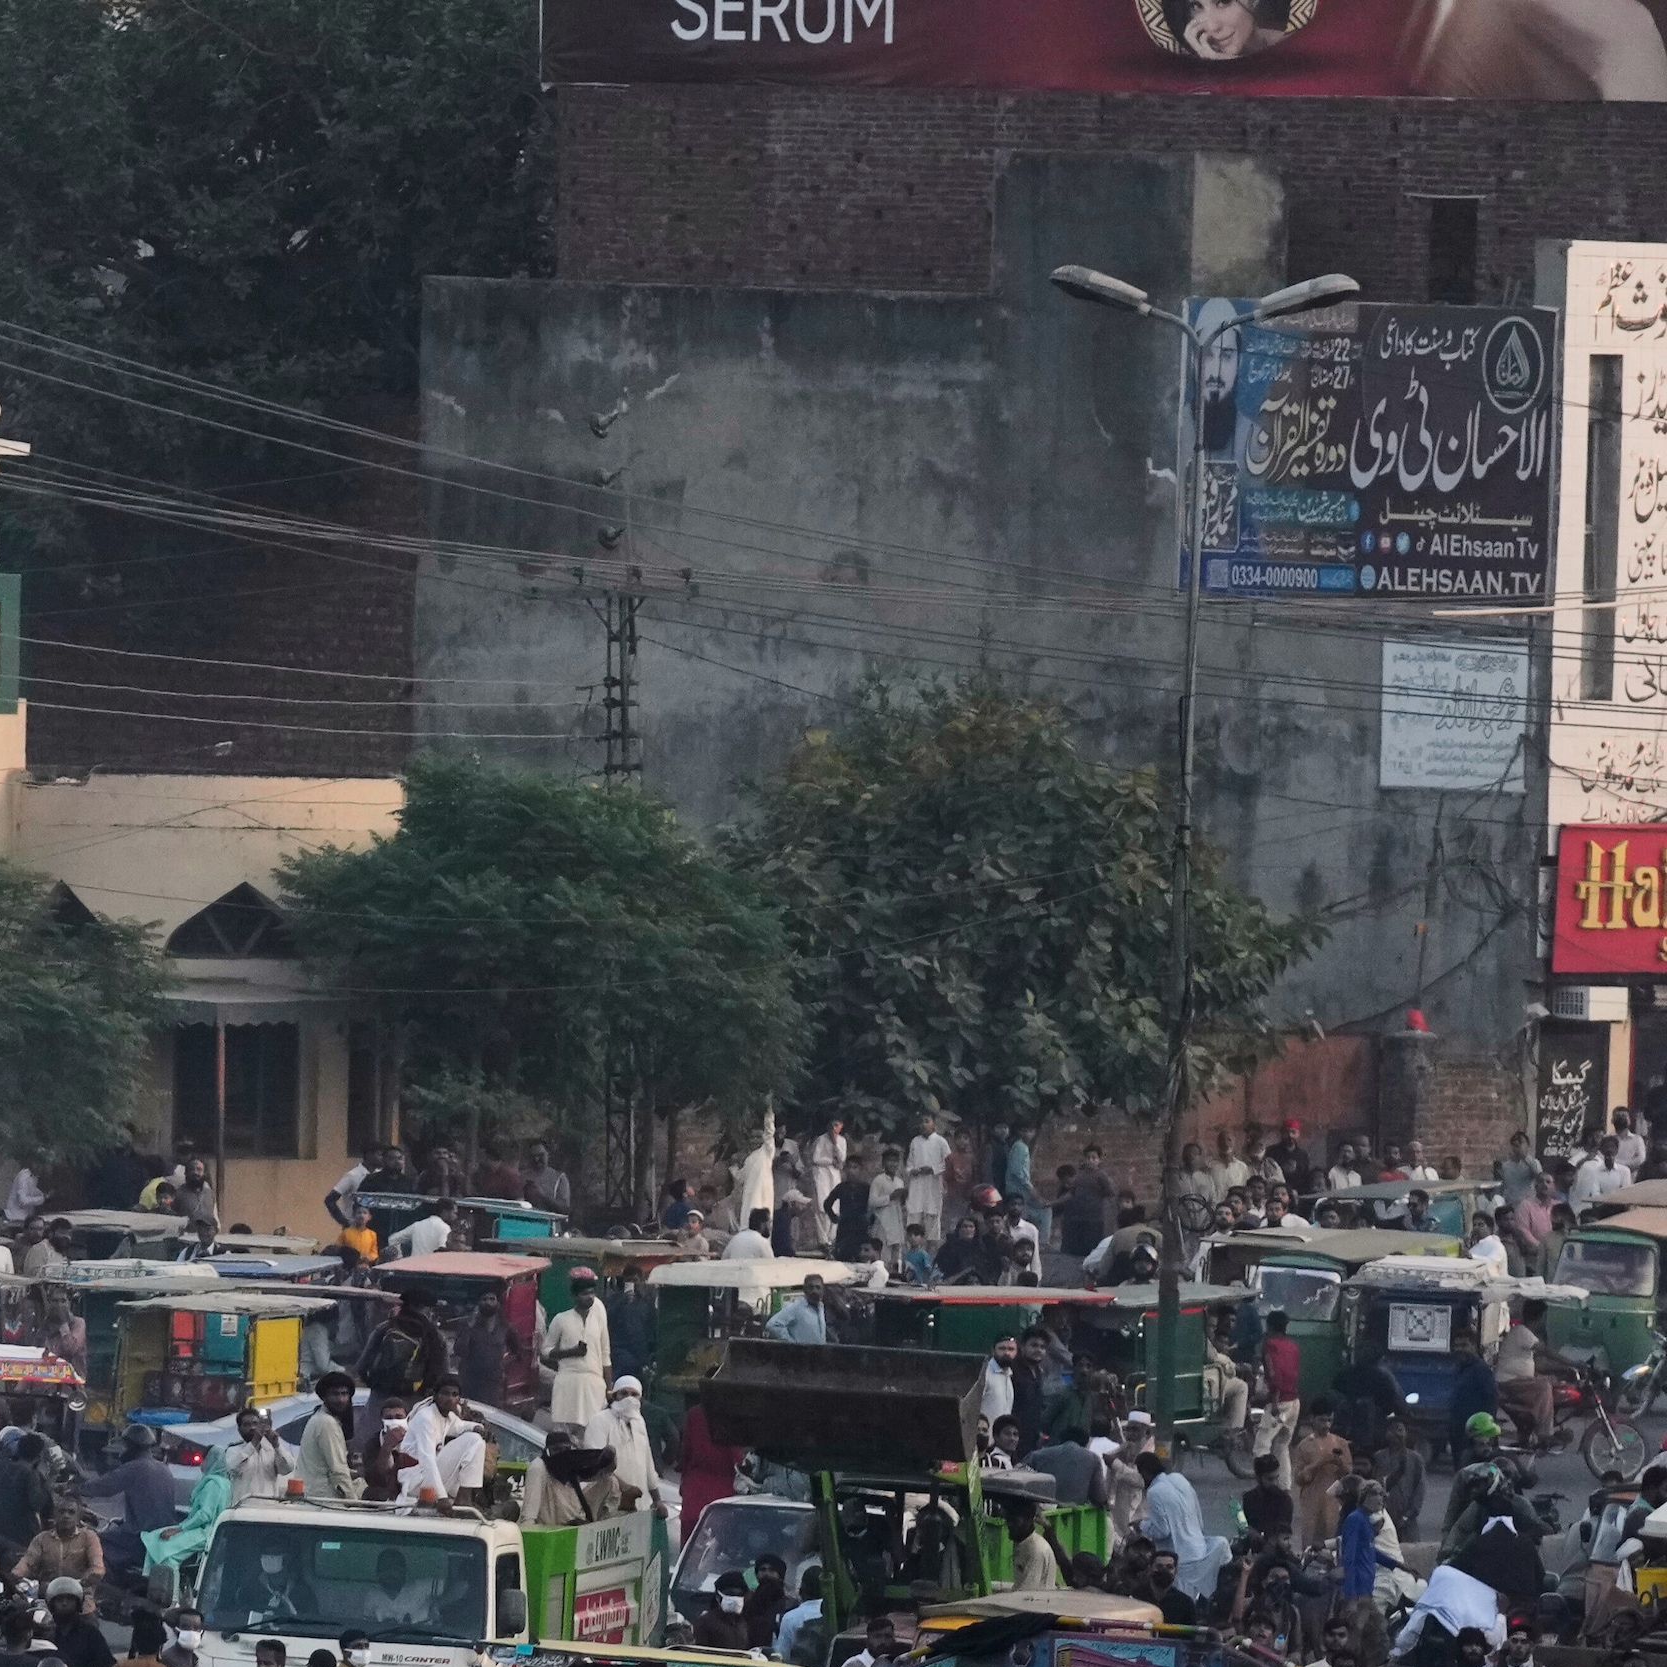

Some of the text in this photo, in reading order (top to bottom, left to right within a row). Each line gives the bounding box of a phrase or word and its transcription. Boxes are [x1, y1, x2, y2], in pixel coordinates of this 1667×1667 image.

[670, 0, 894, 44] SERUM
[1432, 400, 1547, 492] الاحسان
[1376, 566, 1541, 595] ALEHSAAN.TV
[1575, 839, 1667, 930] Ha
[404, 1655, 451, 1665] CANTER
